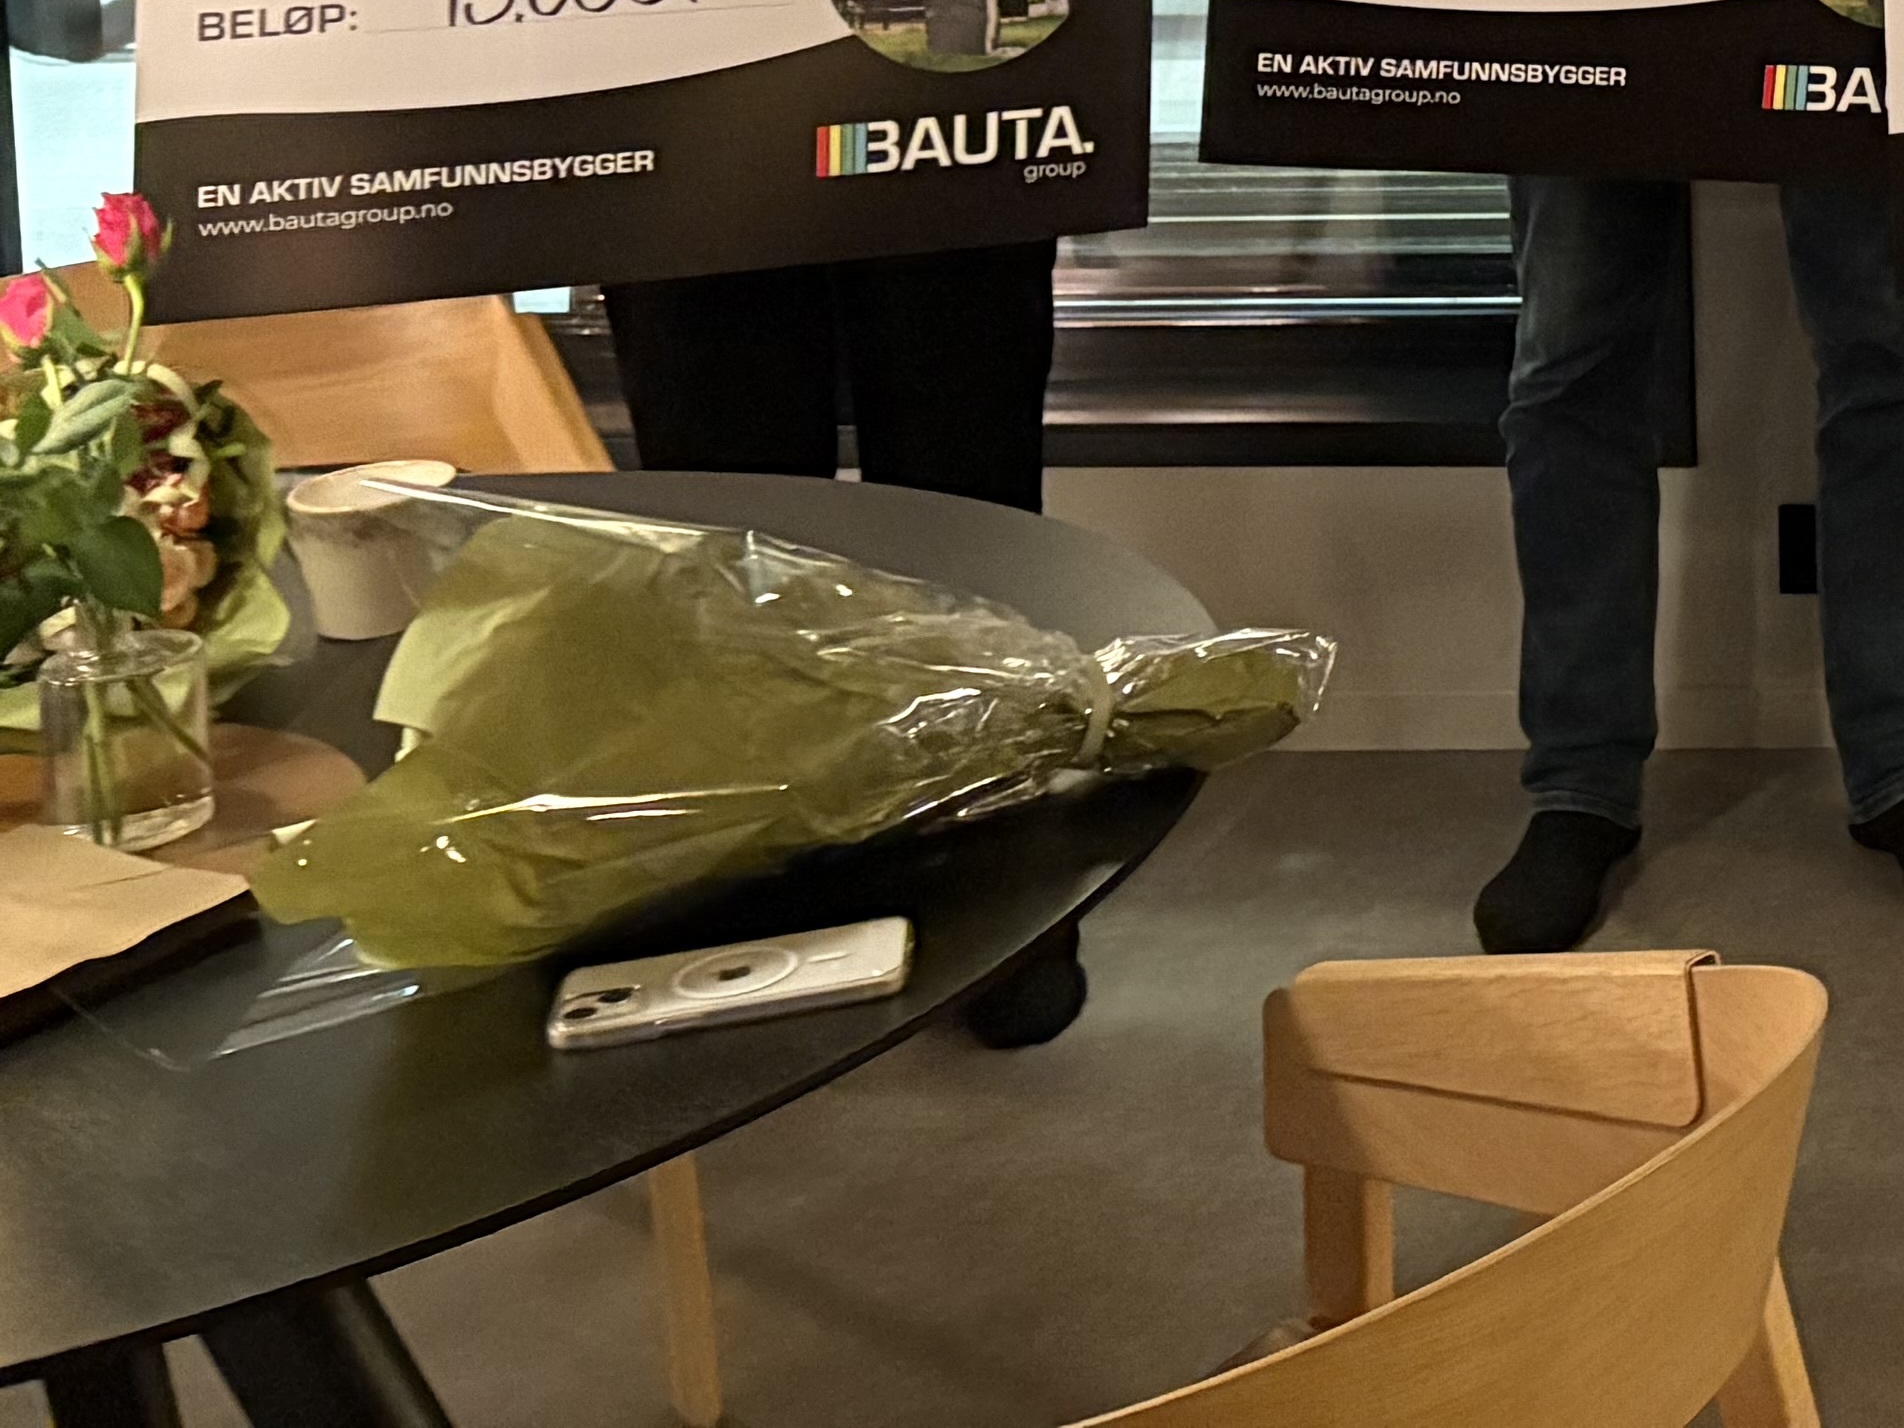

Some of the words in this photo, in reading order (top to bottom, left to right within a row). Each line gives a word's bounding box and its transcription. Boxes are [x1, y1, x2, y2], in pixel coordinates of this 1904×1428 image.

[198, 3, 358, 42] BELØP:
[1257, 52, 1293, 74] EN
[1298, 54, 1375, 77] AKTIV
[1379, 58, 1627, 87] SAMFUNNSBYGGER
[1256, 82, 1461, 106] www.bautagroup.no
[197, 183, 241, 209] EN
[248, 175, 343, 205] AKTIV
[349, 149, 655, 196] SAMFUNNSBYGGER
[1023, 161, 1086, 184] group
[198, 202, 453, 237] www.bautagroup.no
